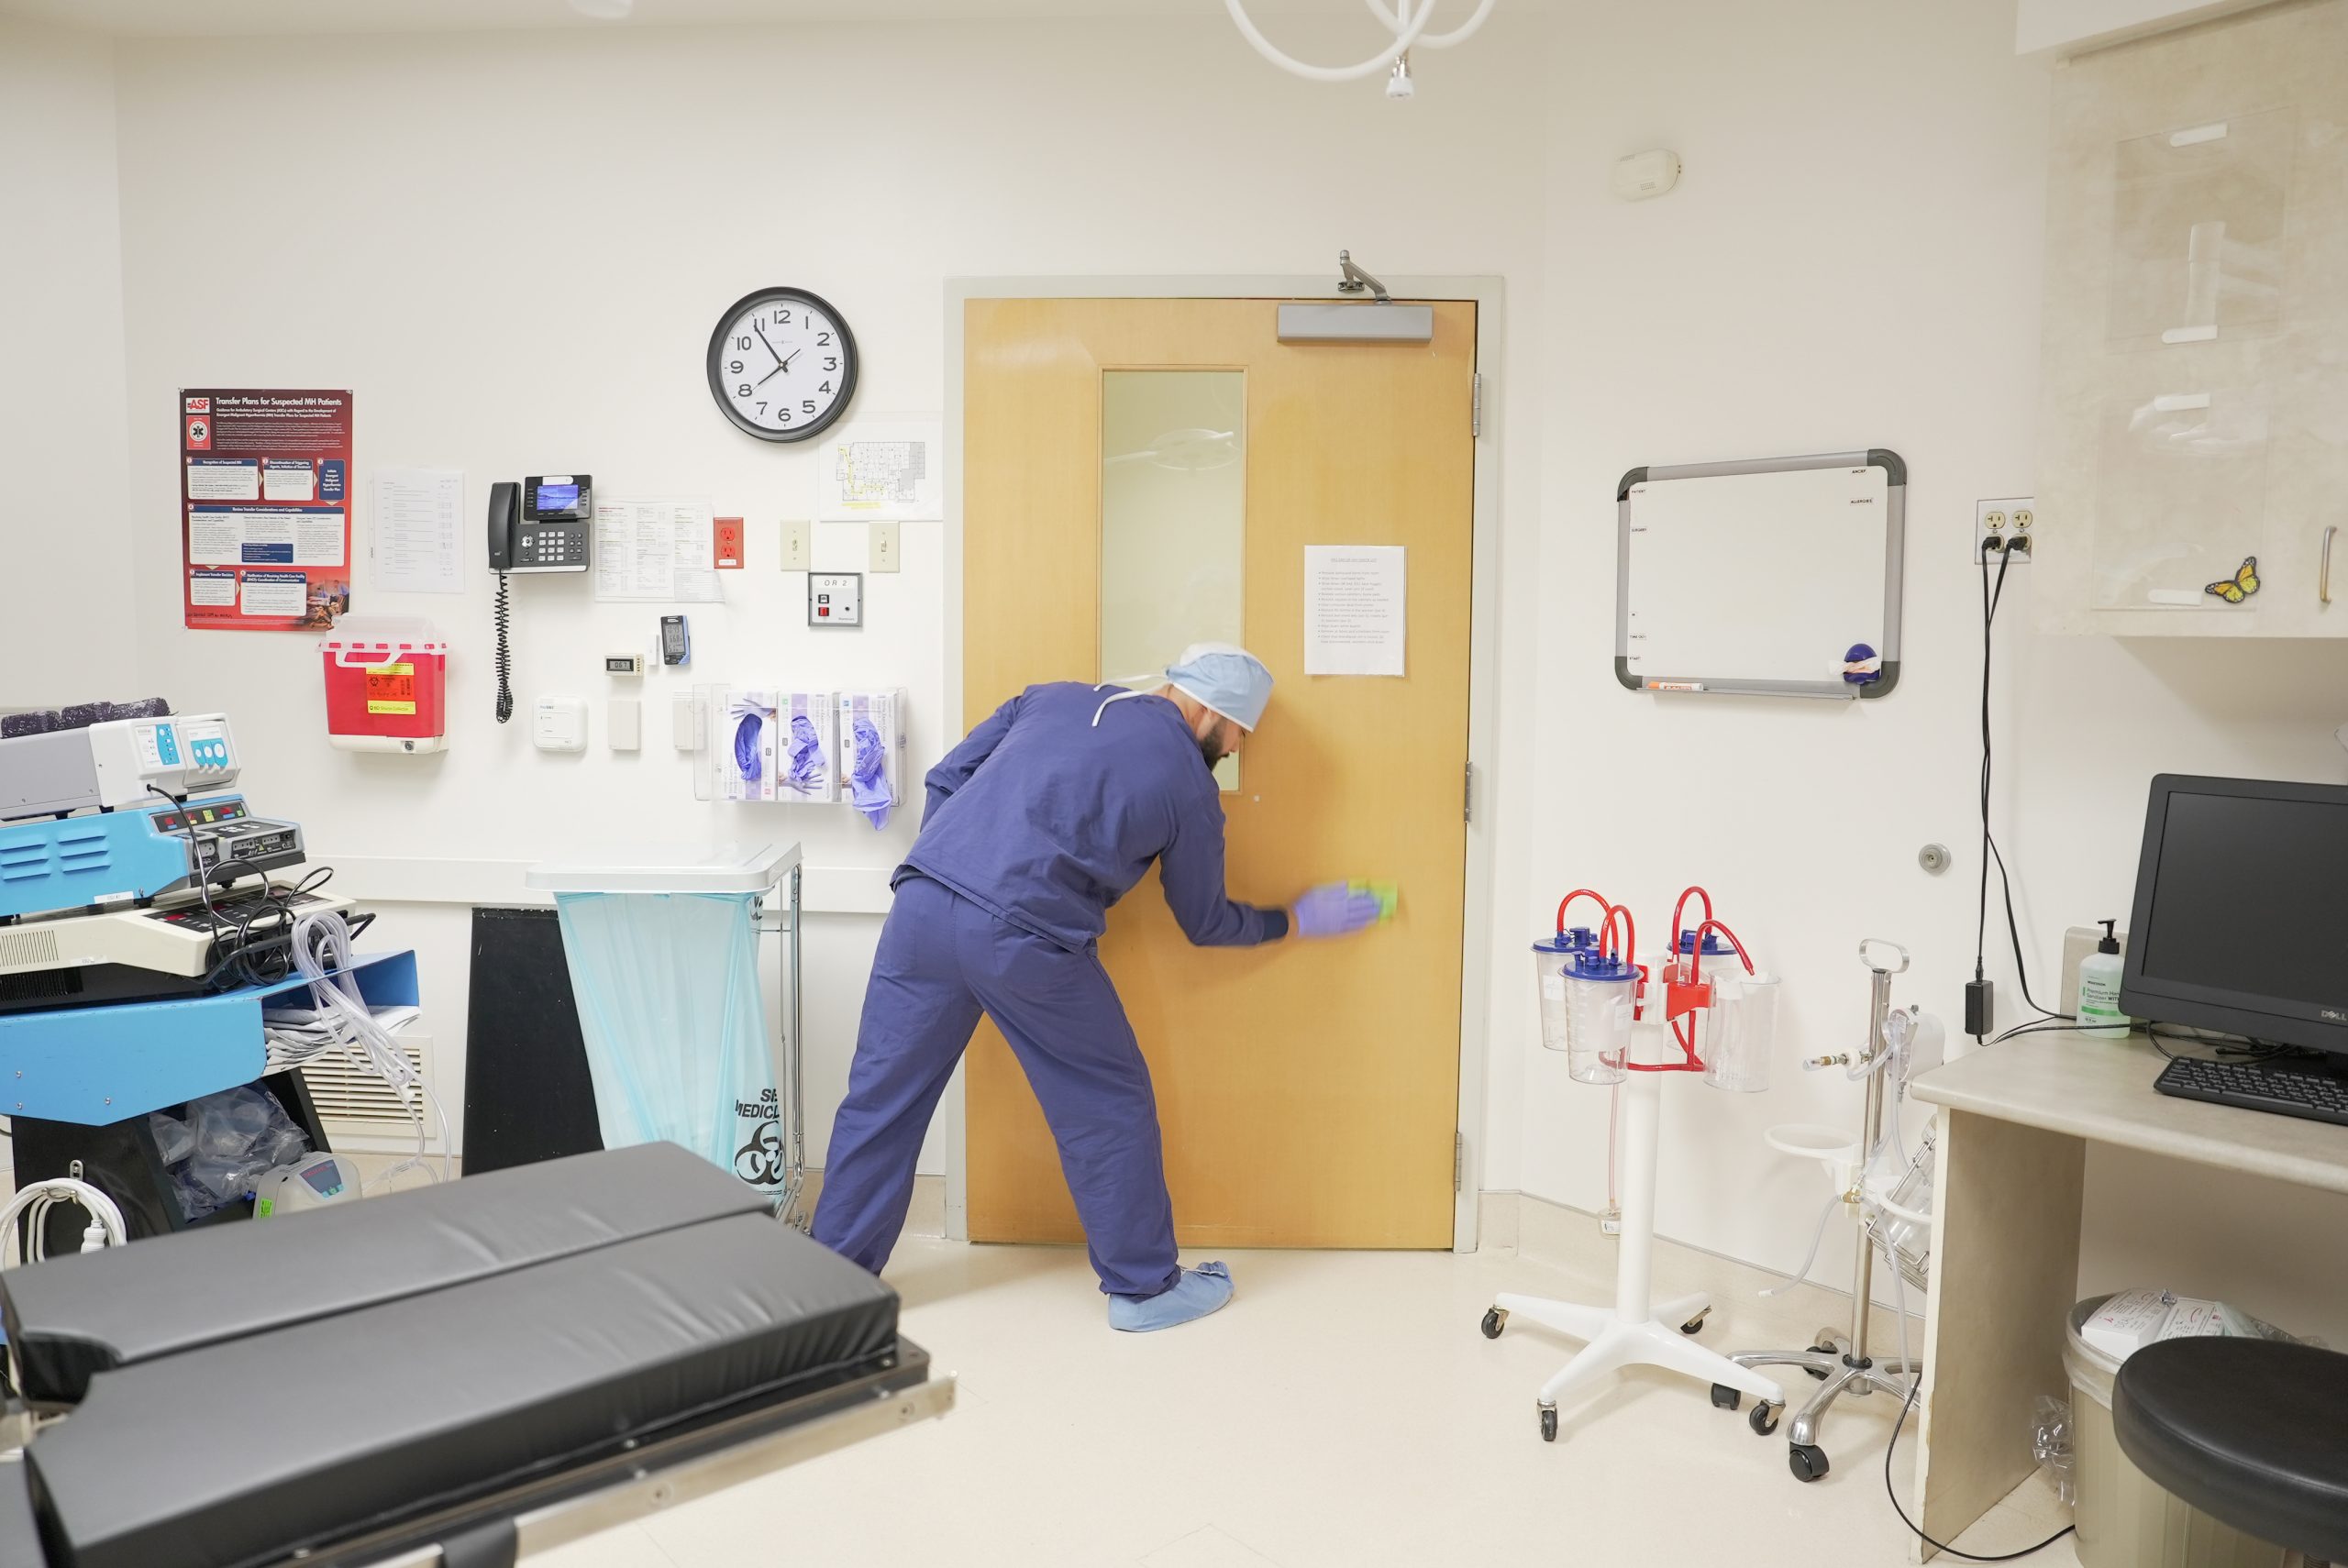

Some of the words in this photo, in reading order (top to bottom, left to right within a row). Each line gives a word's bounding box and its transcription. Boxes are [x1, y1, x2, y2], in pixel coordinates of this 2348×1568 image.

[774, 310, 791, 325] 12
[805, 316, 809, 330] 1
[754, 318, 765, 332] 11
[737, 336, 752, 350] 10
[816, 332, 831, 347] 2
[730, 360, 744, 374] 9
[823, 358, 837, 371] 3
[737, 383, 753, 397] 8
[818, 381, 832, 394] 4
[260, 397, 270, 405] for
[271, 397, 303, 407] Suspected
[756, 402, 769, 416] 7
[802, 400, 816, 414] 5
[778, 408, 792, 422] 6
[2320, 1010, 2347, 1021] DELL
